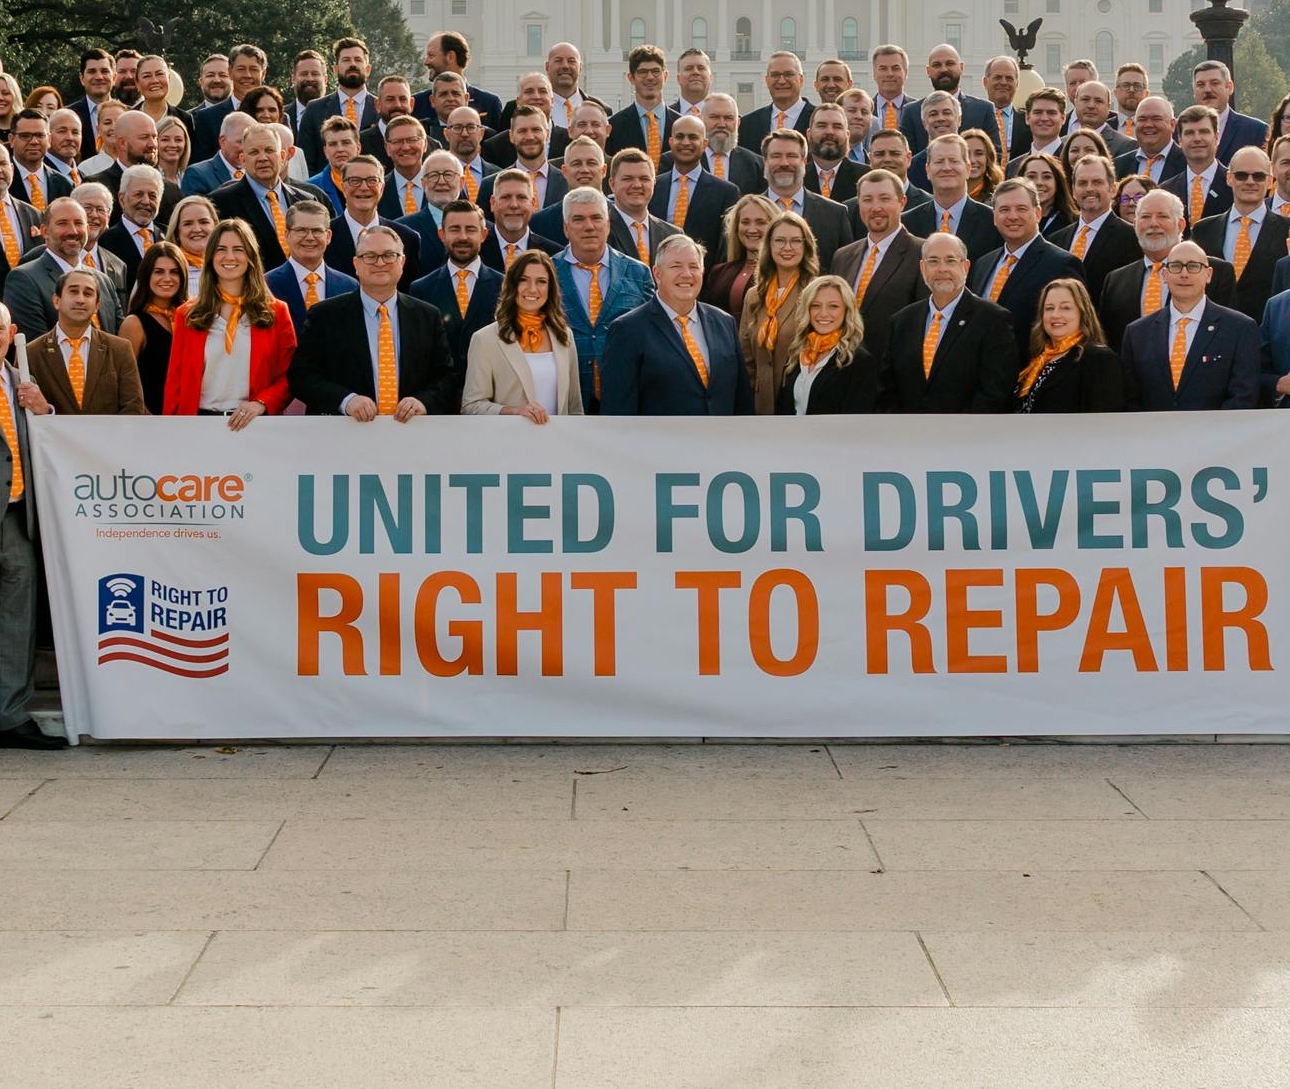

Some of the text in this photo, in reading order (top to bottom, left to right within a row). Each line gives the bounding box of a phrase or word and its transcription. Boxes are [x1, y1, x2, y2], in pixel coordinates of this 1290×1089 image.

[75, 503, 245, 520] ASSOCIATION
[297, 466, 1269, 556] UNITED FOR DRIVERS’
[95, 527, 222, 541] Independence drives us.
[151, 579, 229, 606] RIGHT TO
[151, 601, 227, 632] REPAIR
[295, 565, 1275, 678] RIGHT TO REPAIR
